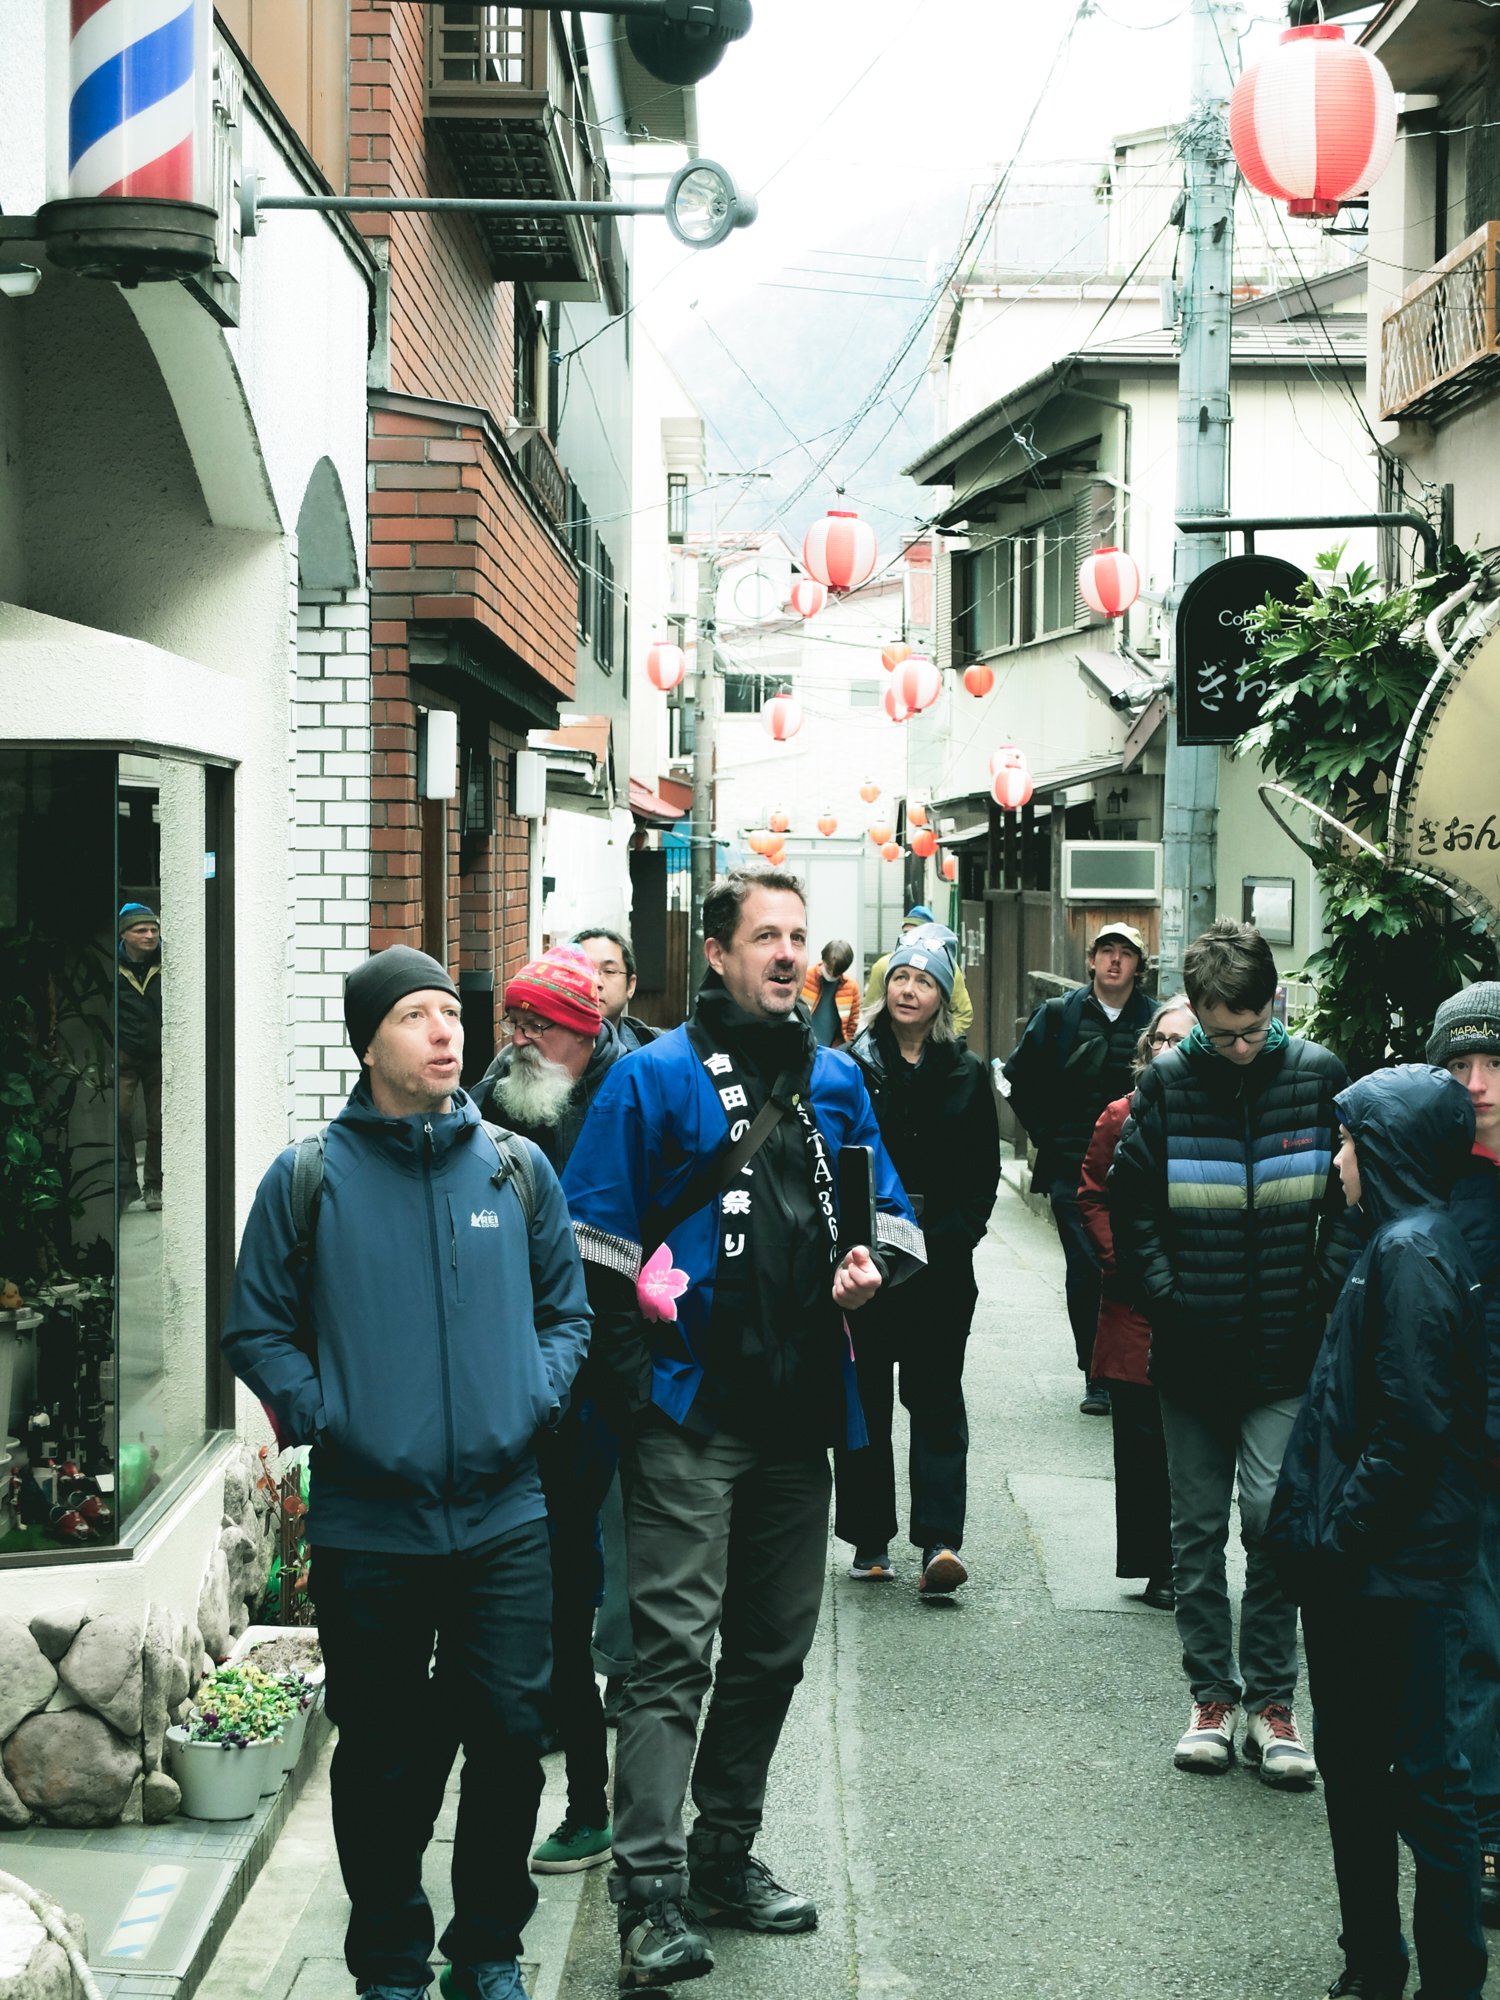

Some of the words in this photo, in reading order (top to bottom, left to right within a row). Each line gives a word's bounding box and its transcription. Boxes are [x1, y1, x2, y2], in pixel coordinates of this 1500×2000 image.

[1245, 629, 1255, 645] &
[1418, 814, 1500, 855] ぎおん
[1450, 1025, 1478, 1038] MAPA
[703, 1053, 752, 1258] 吉田の祭り
